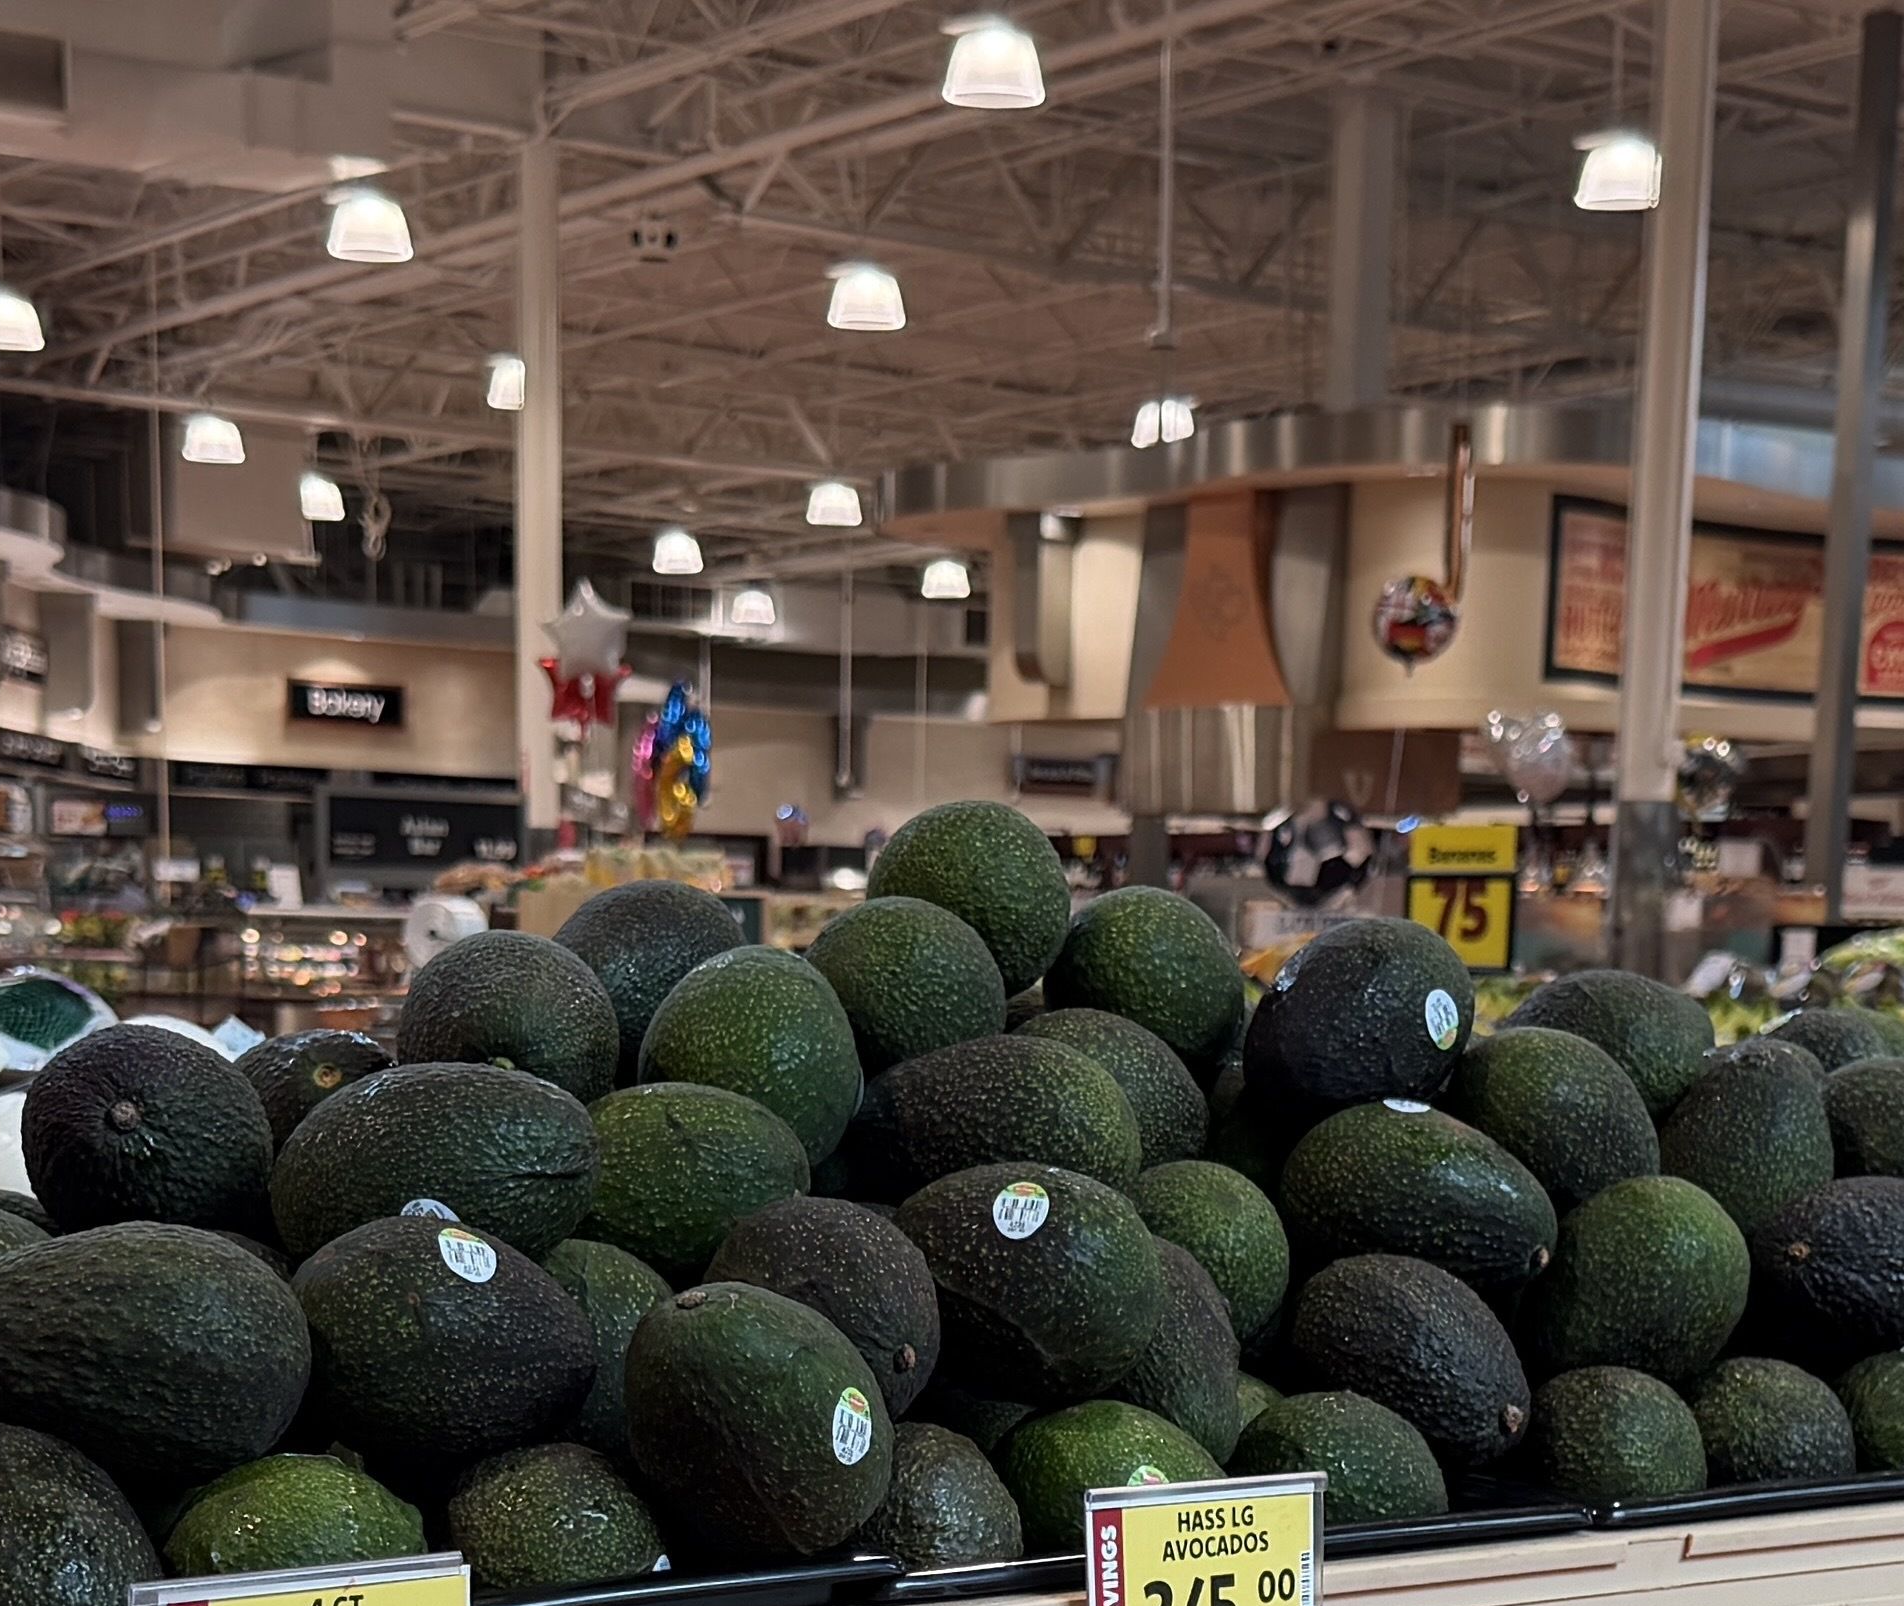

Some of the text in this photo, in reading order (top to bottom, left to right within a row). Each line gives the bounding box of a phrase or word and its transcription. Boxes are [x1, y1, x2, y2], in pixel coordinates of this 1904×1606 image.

[306, 686, 386, 724] Bakery
[1433, 878, 1488, 942] 75
[1177, 1504, 1255, 1533] HASS LG
[1162, 1530, 1270, 1562] AVOCADOS
